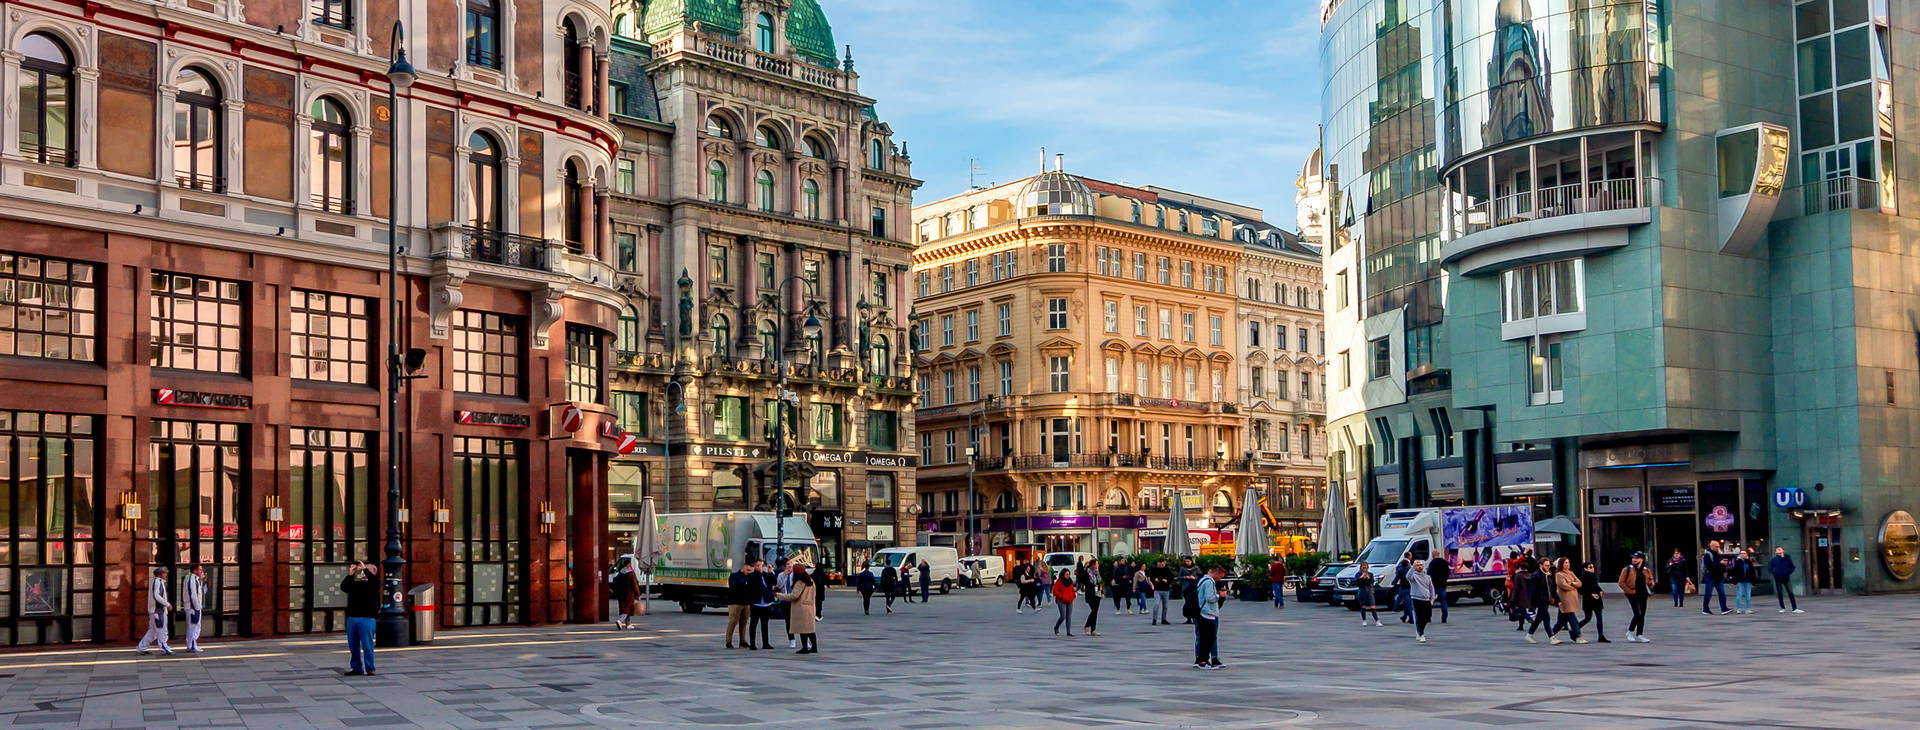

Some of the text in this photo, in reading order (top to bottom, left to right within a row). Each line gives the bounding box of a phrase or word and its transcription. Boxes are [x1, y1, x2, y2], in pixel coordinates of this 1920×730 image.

[706, 447, 749, 457] PILSTL
[813, 452, 842, 463] OMEGA
[870, 456, 897, 466] OMEGA
[1611, 496, 1633, 504] ONYX
[1776, 492, 1790, 506] U
[1795, 492, 1804, 506] U
